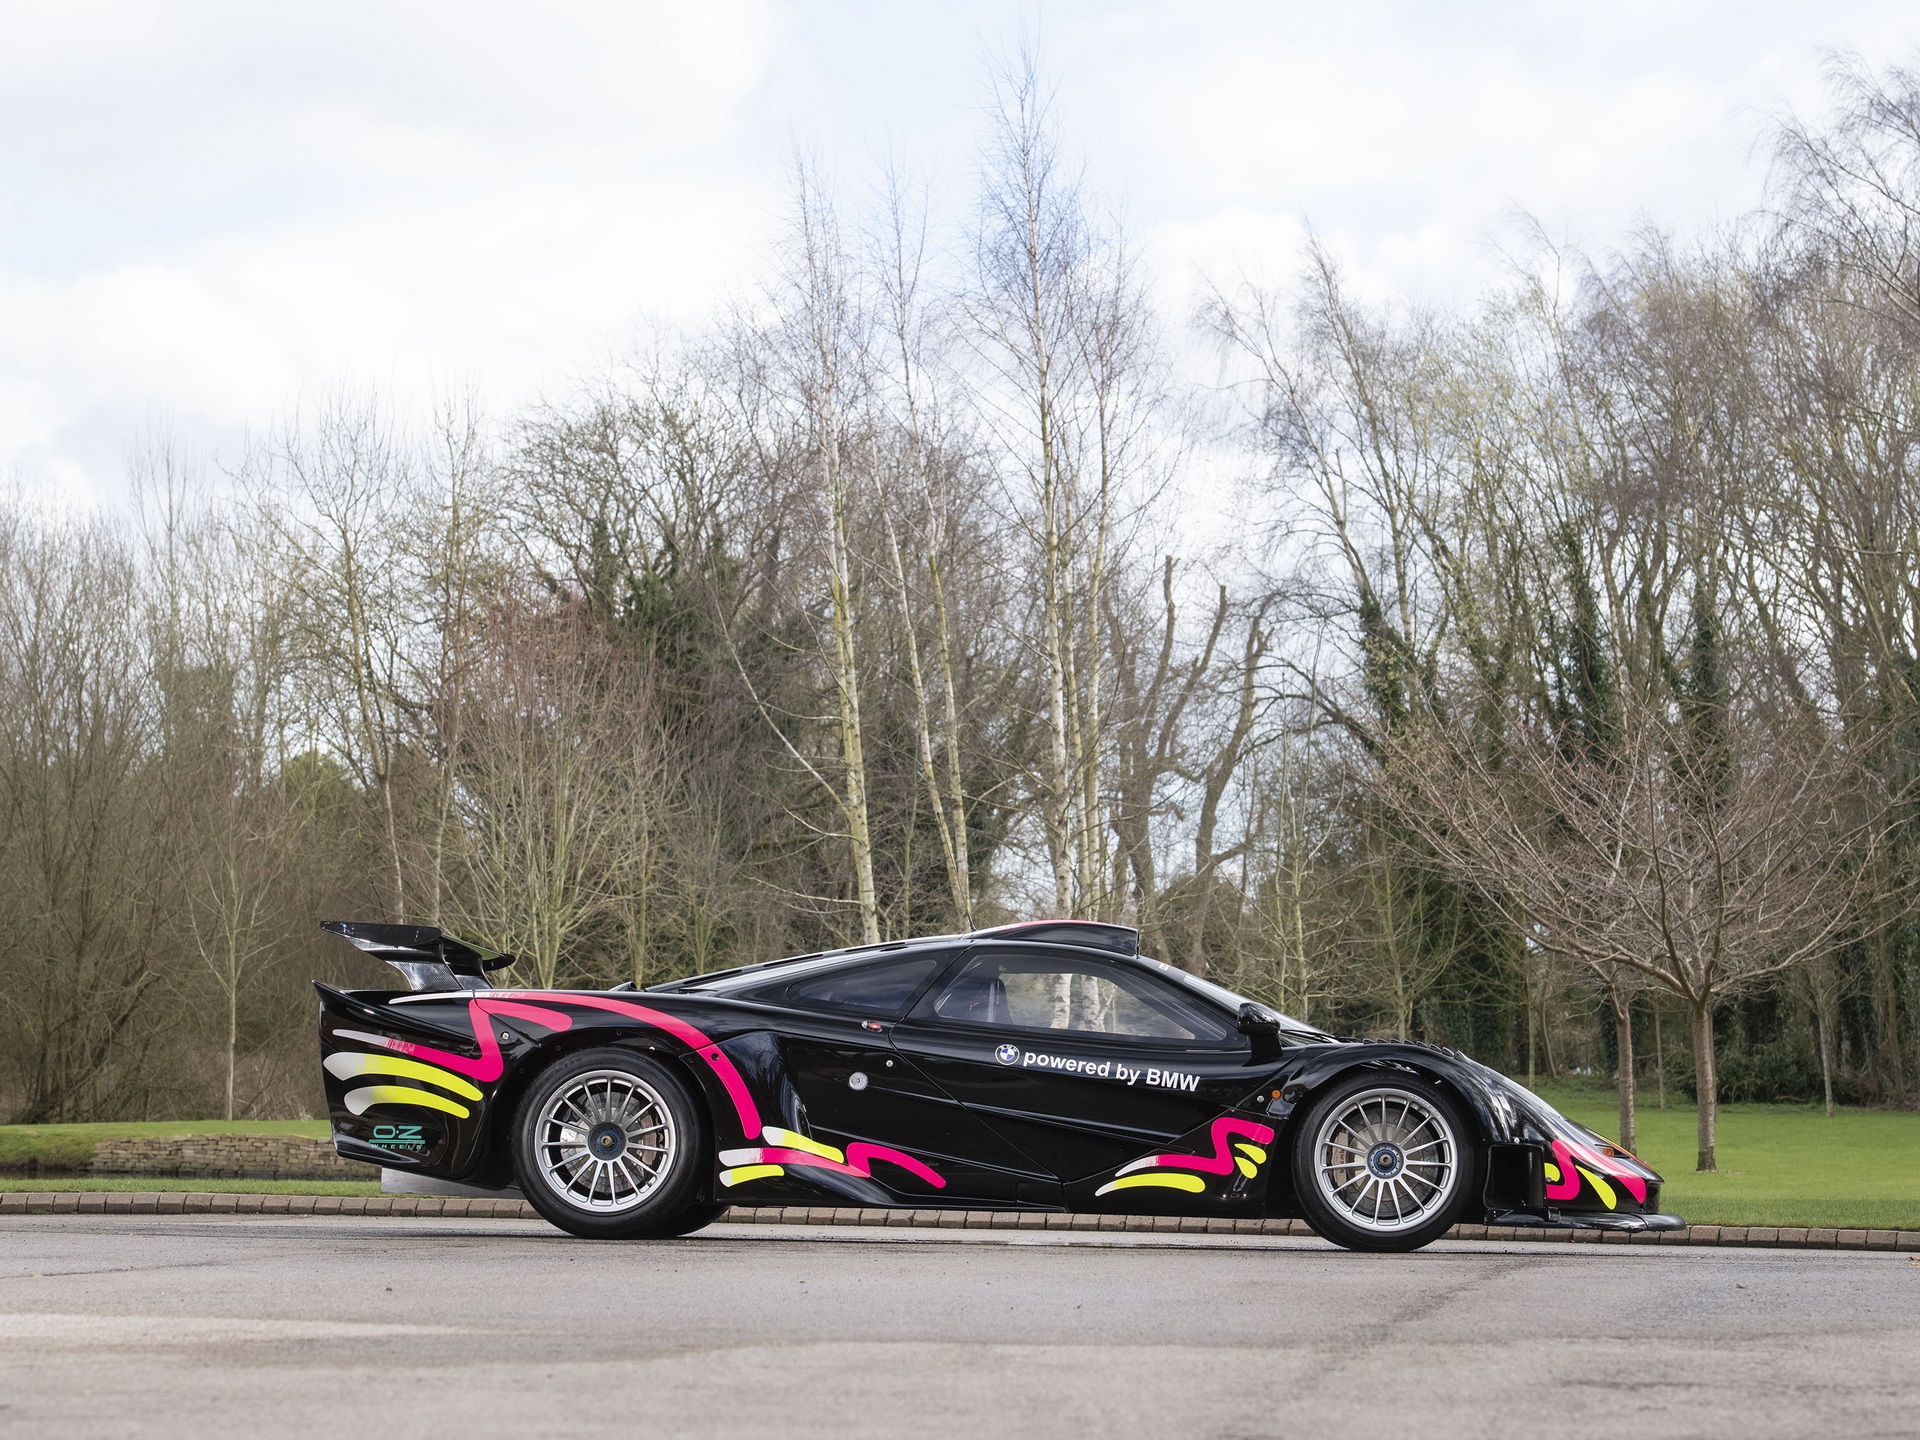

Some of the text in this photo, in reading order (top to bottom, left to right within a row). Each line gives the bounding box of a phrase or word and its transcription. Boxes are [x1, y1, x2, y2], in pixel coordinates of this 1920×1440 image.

[1022, 1050, 1200, 1092] powered by BMW
